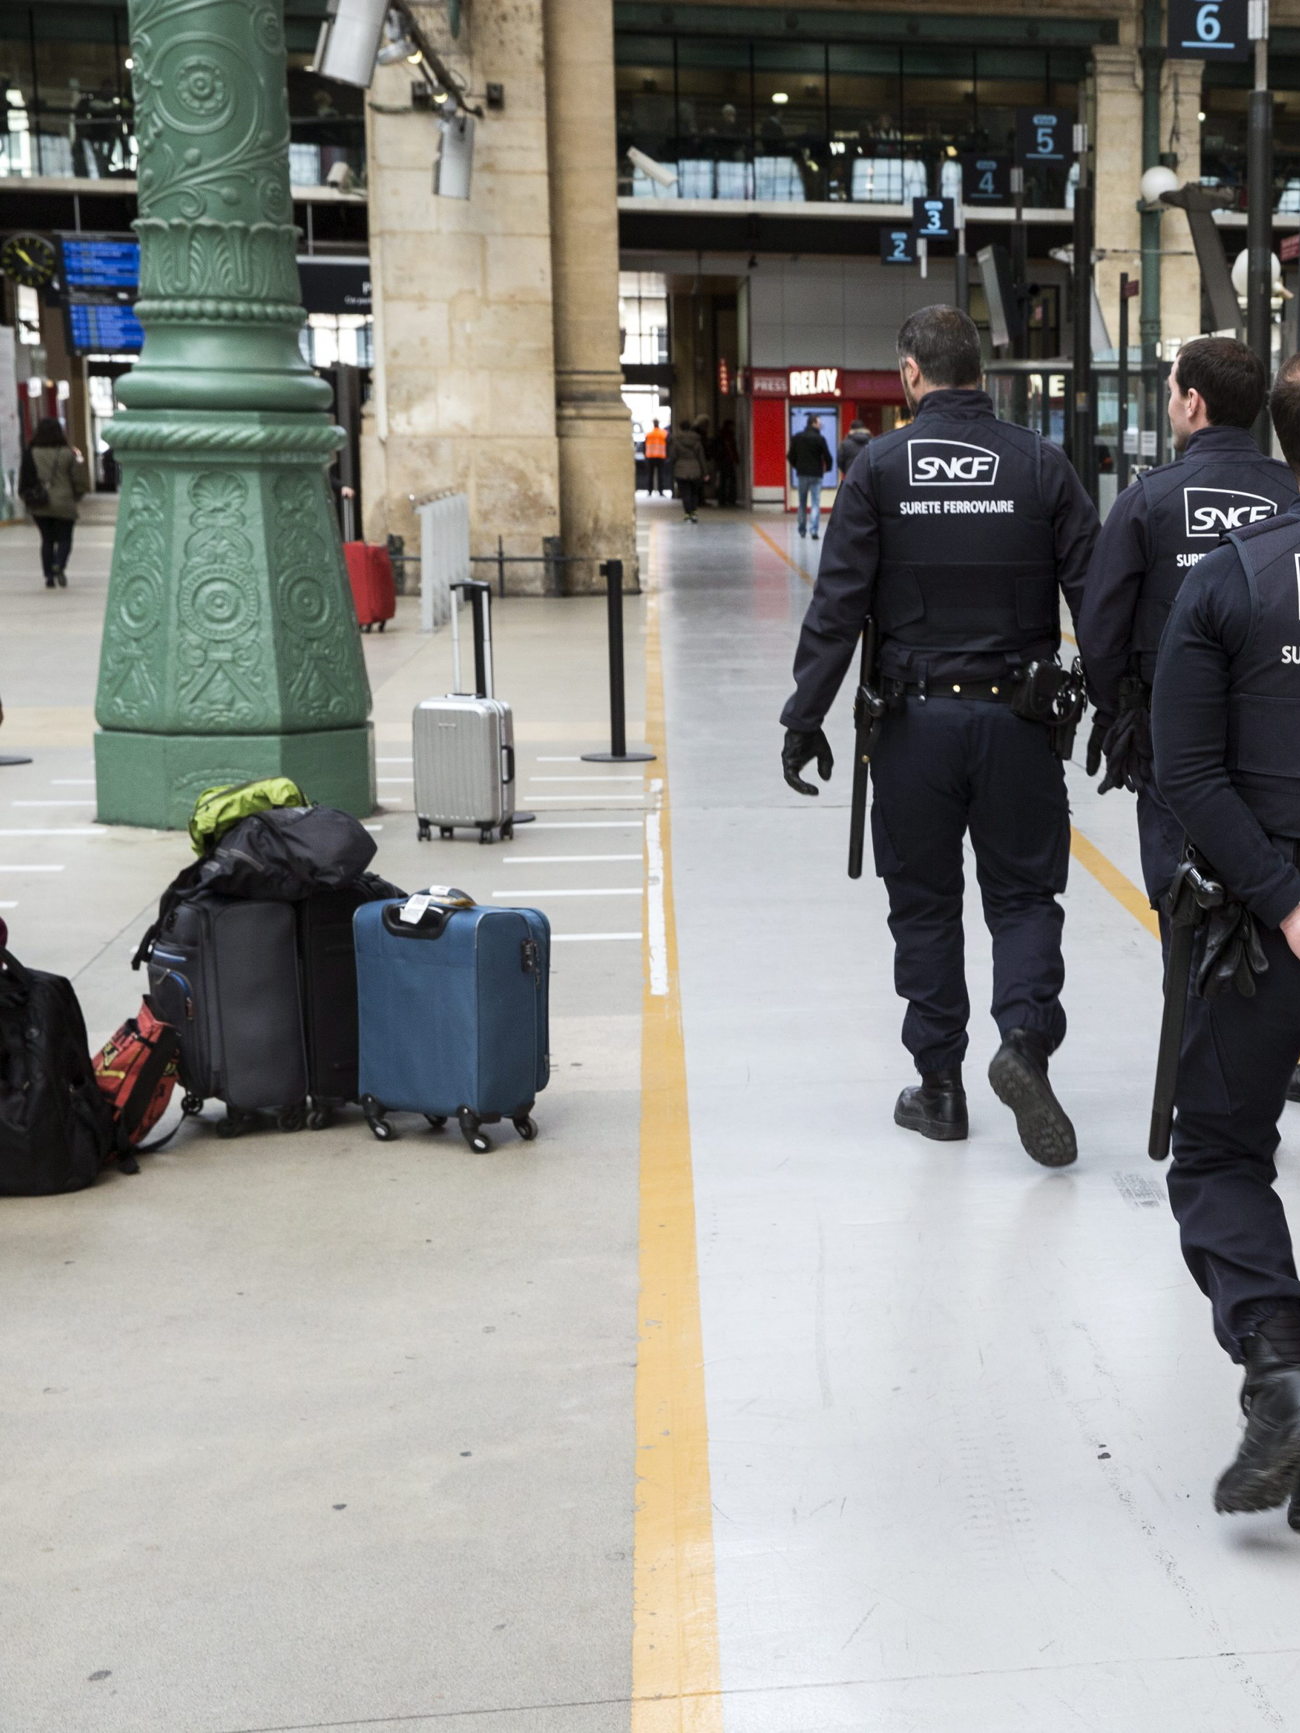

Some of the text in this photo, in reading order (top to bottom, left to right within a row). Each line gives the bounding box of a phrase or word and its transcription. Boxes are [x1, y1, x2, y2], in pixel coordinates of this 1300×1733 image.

[1196, 3, 1221, 41] 6
[1036, 127, 1054, 154] 5
[979, 171, 995, 193] 4
[927, 210, 941, 229] 3
[893, 240, 906, 257] 2
[914, 456, 994, 480] SNCF
[899, 499, 1015, 515] SURETE FERROVIAIRE
[1191, 505, 1272, 531] SNCF
